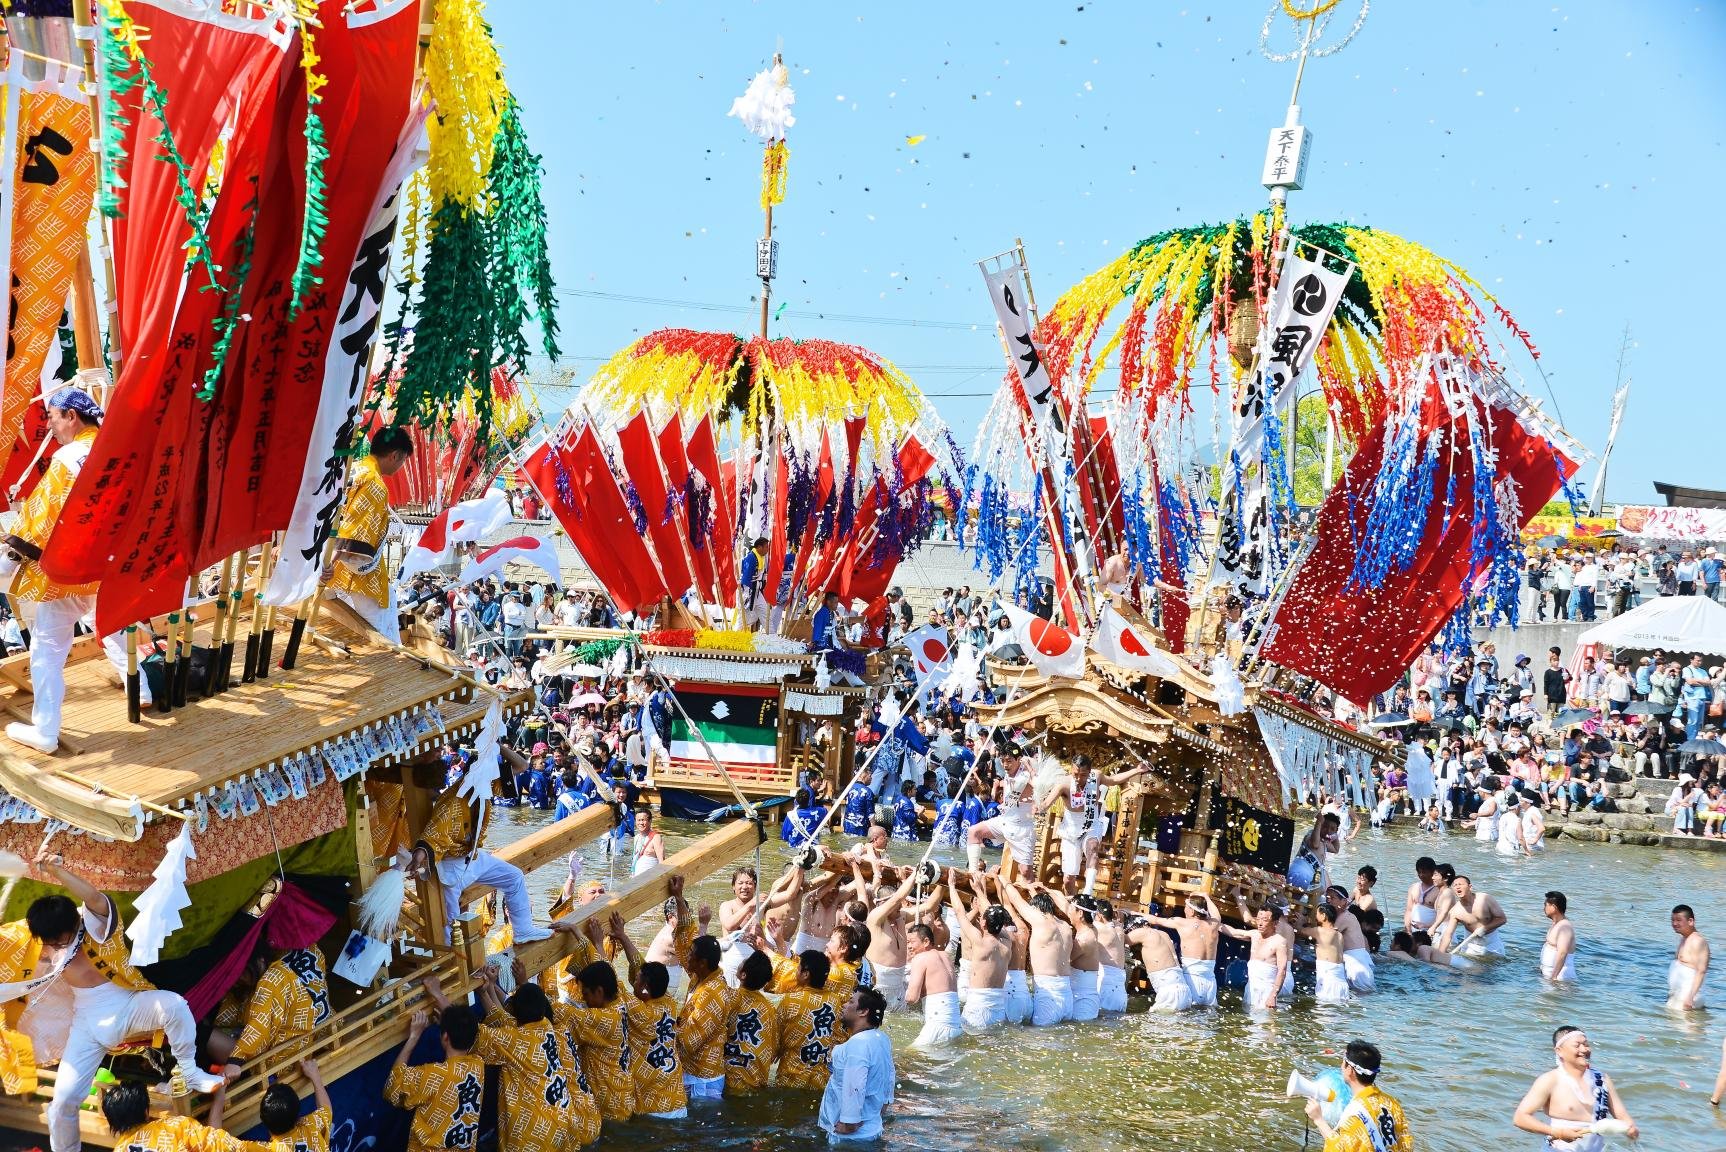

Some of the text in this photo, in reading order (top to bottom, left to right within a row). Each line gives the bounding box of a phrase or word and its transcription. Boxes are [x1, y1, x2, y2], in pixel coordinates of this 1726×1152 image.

[1271, 129, 1295, 181] 天下泰平
[647, 1012, 676, 1073] 魚町
[800, 1003, 836, 1067] 魚町
[541, 1032, 570, 1108] 魚町
[445, 1073, 481, 1148] 魚町
[1378, 1107, 1397, 1152] 魚
